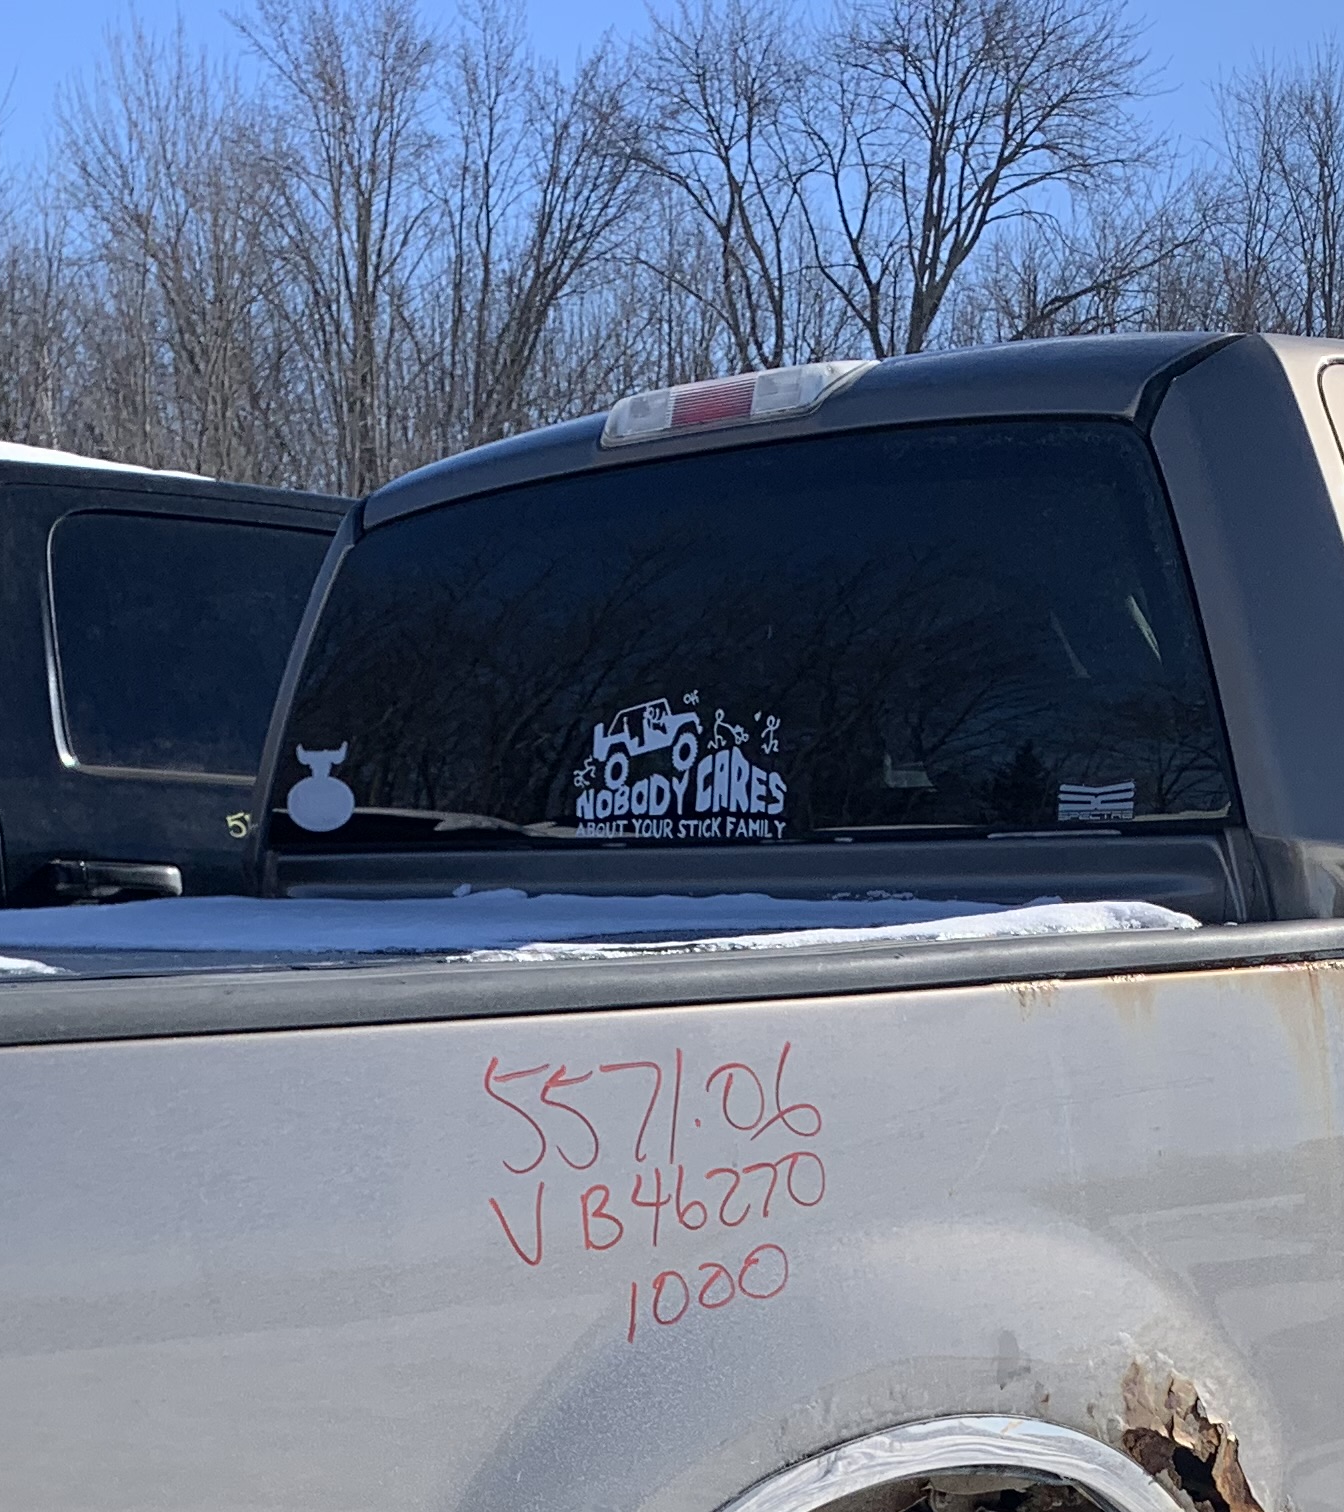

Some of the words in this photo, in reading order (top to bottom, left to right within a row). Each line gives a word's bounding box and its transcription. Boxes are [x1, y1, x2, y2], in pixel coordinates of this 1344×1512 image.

[575, 771, 690, 820] NOBODY
[695, 746, 788, 815] CARES
[575, 819, 628, 839] ABOUT
[632, 818, 674, 839] YOUR
[677, 817, 721, 839] STICK
[726, 816, 787, 839] FAMILY
